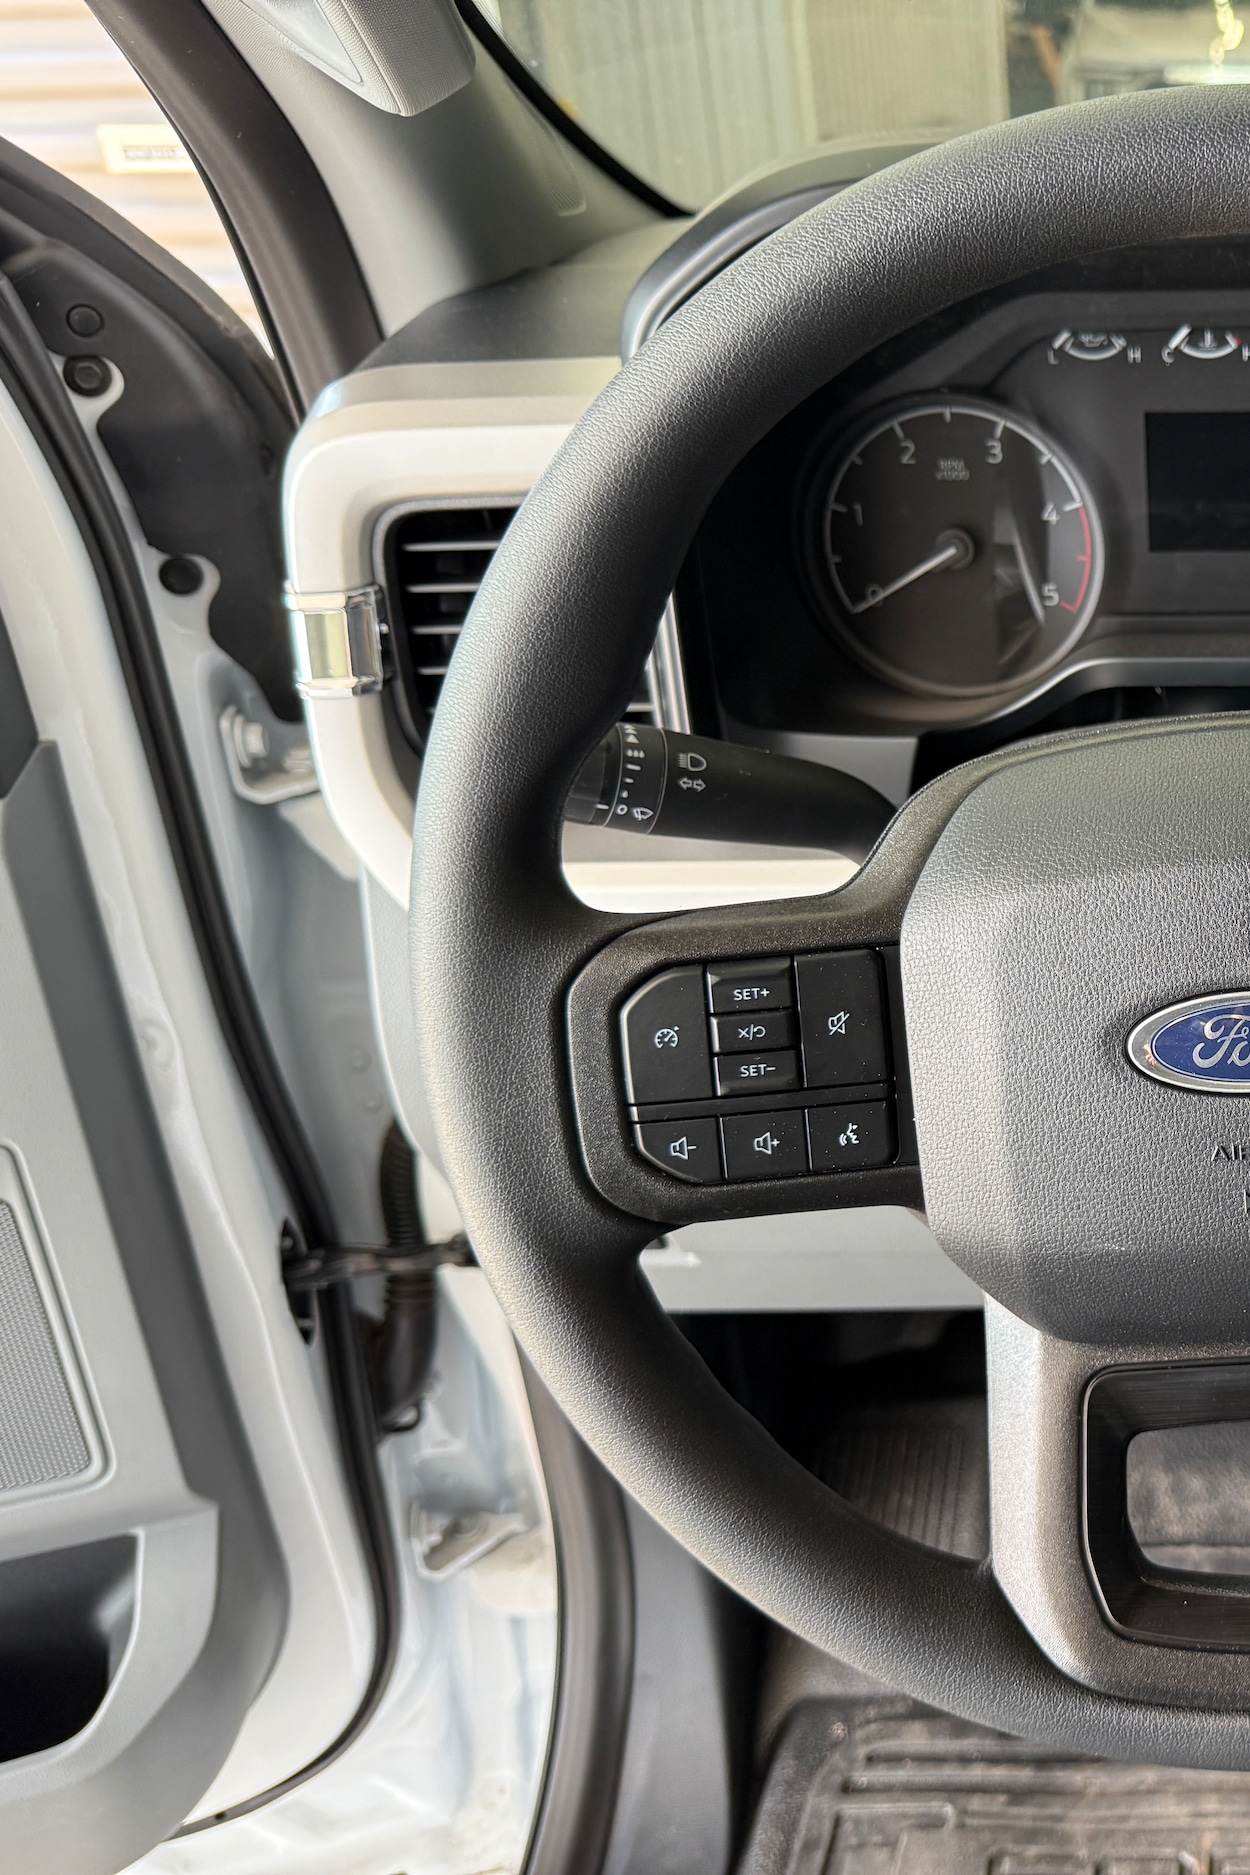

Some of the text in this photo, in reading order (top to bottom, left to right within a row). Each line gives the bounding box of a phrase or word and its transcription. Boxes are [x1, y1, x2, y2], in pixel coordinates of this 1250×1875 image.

[901, 440, 917, 465] 2
[985, 439, 1003, 464] 3
[1041, 503, 1061, 526] 4
[1042, 583, 1060, 607] 5
[733, 988, 770, 1001] SET+
[740, 1064, 776, 1078] SET-
